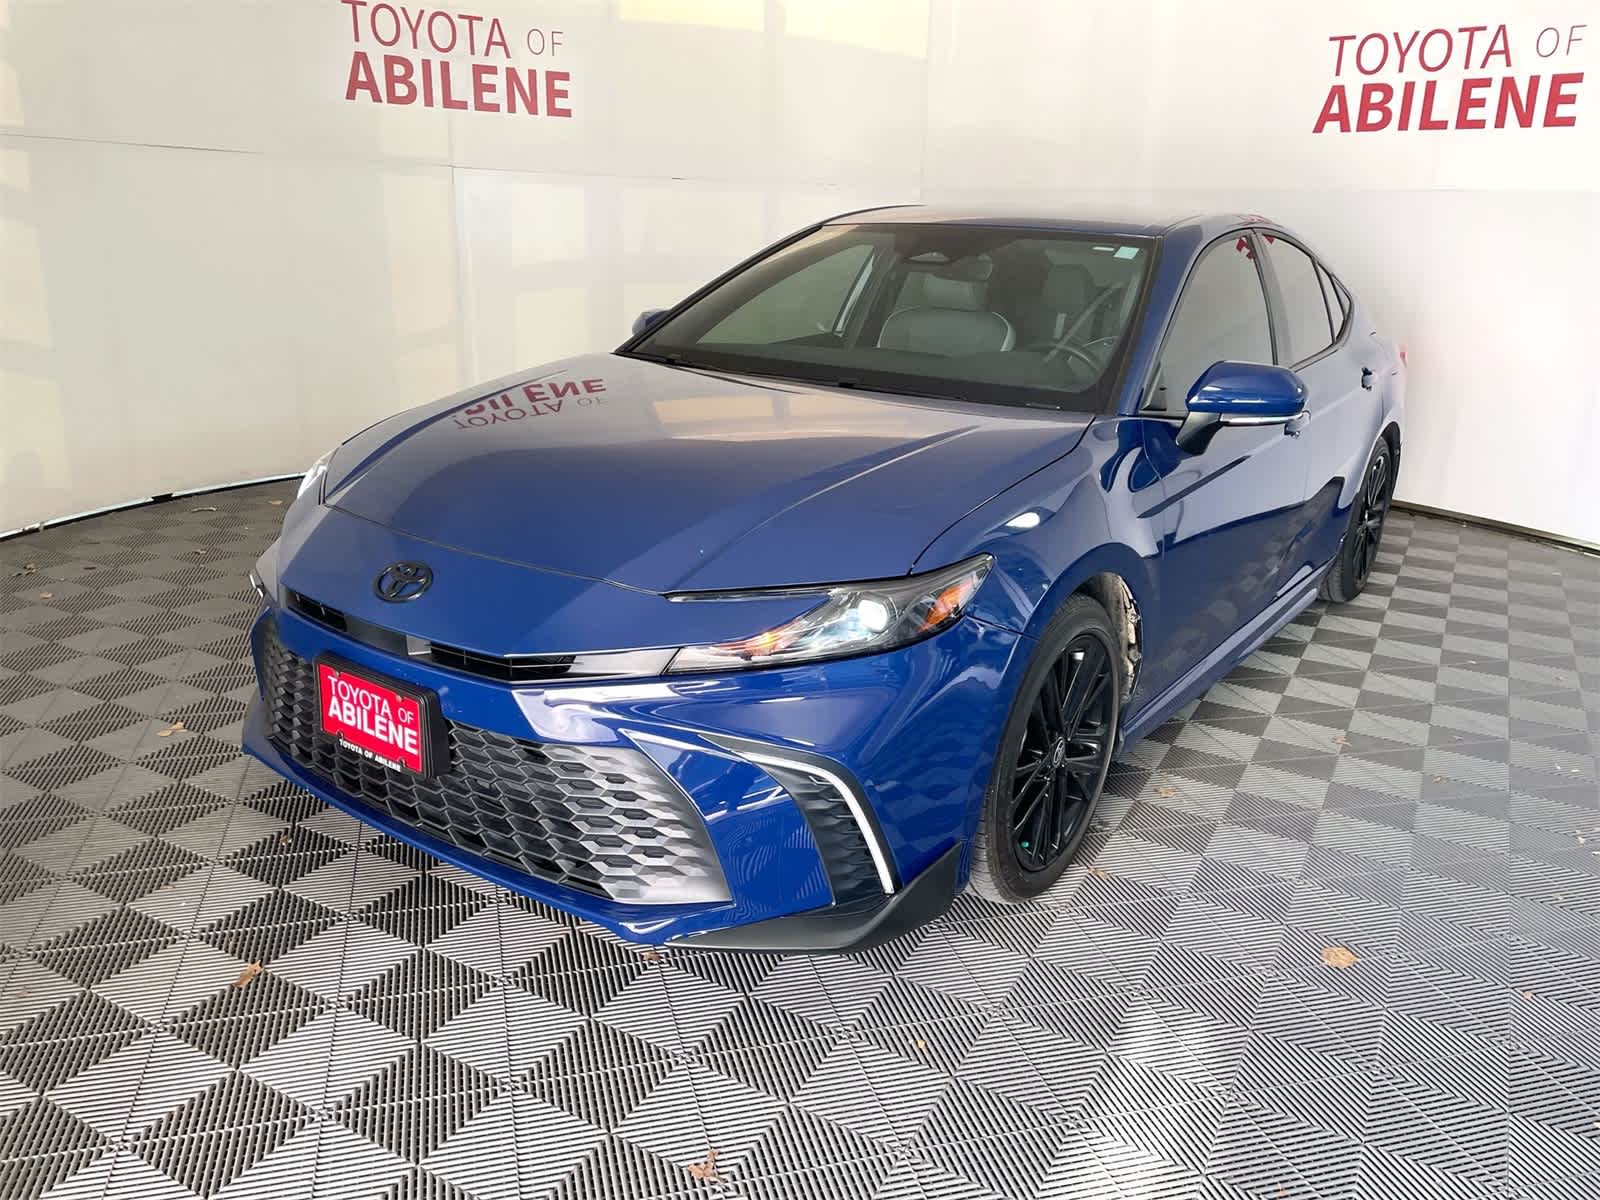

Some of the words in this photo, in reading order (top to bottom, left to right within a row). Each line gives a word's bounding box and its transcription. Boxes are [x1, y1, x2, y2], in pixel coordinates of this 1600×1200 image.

[341, 0, 512, 59] TOYOTA
[527, 28, 564, 56] OF
[1329, 24, 1512, 76] TOYOTA
[1536, 24, 1588, 58] OF
[345, 51, 572, 118] ABILENE
[1312, 72, 1585, 134] ABILENE
[327, 675, 393, 720] TOYOTA
[397, 707, 414, 724] OF
[328, 695, 419, 756] ABILENE
[339, 738, 363, 755] TOYOTA
[364, 749, 374, 759] OF
[374, 754, 401, 772] ABILENE
